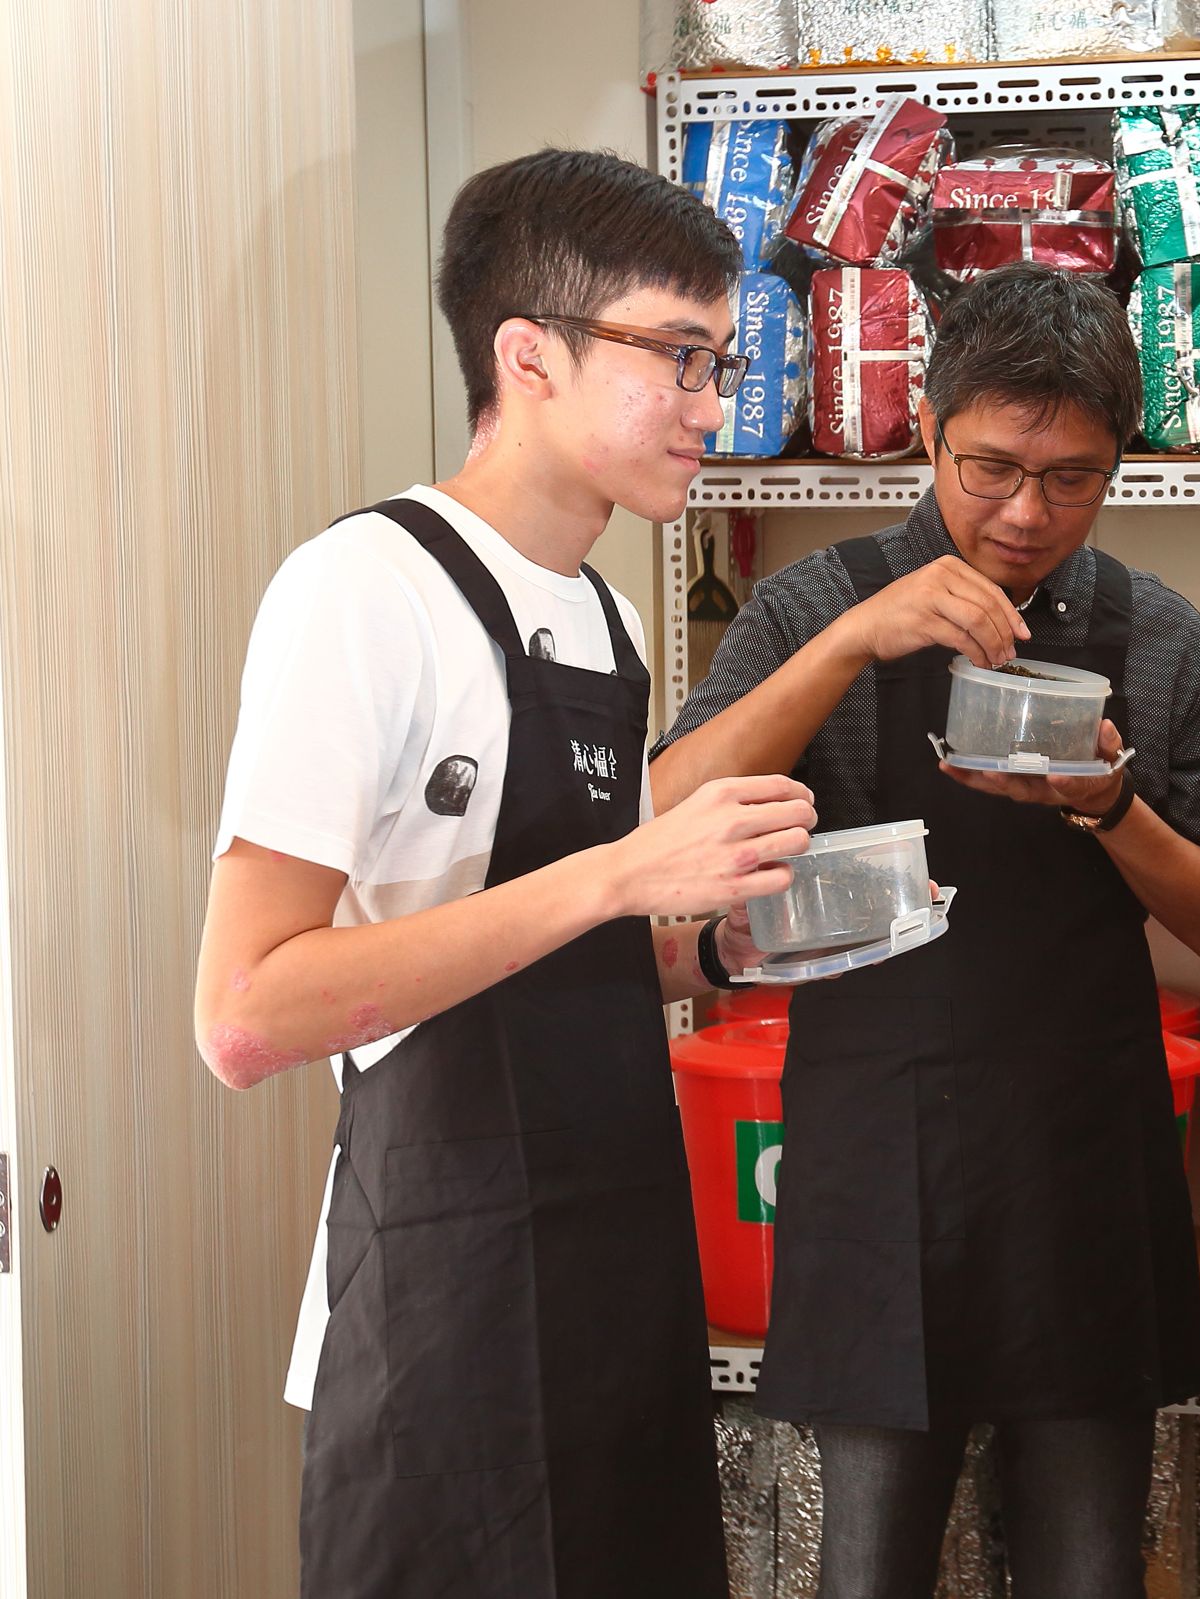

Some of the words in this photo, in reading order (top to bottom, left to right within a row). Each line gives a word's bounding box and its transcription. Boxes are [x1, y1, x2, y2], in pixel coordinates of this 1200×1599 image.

[725, 192, 753, 249] 198
[806, 165, 843, 225] Since
[950, 186, 1020, 209] Since
[744, 291, 770, 361] Since
[827, 287, 844, 353] 1987
[1156, 285, 1178, 350] 1987
[741, 372, 767, 439] 1987
[828, 365, 844, 435] Since
[1162, 362, 1184, 430] Since
[570, 739, 618, 780] 清心福全
